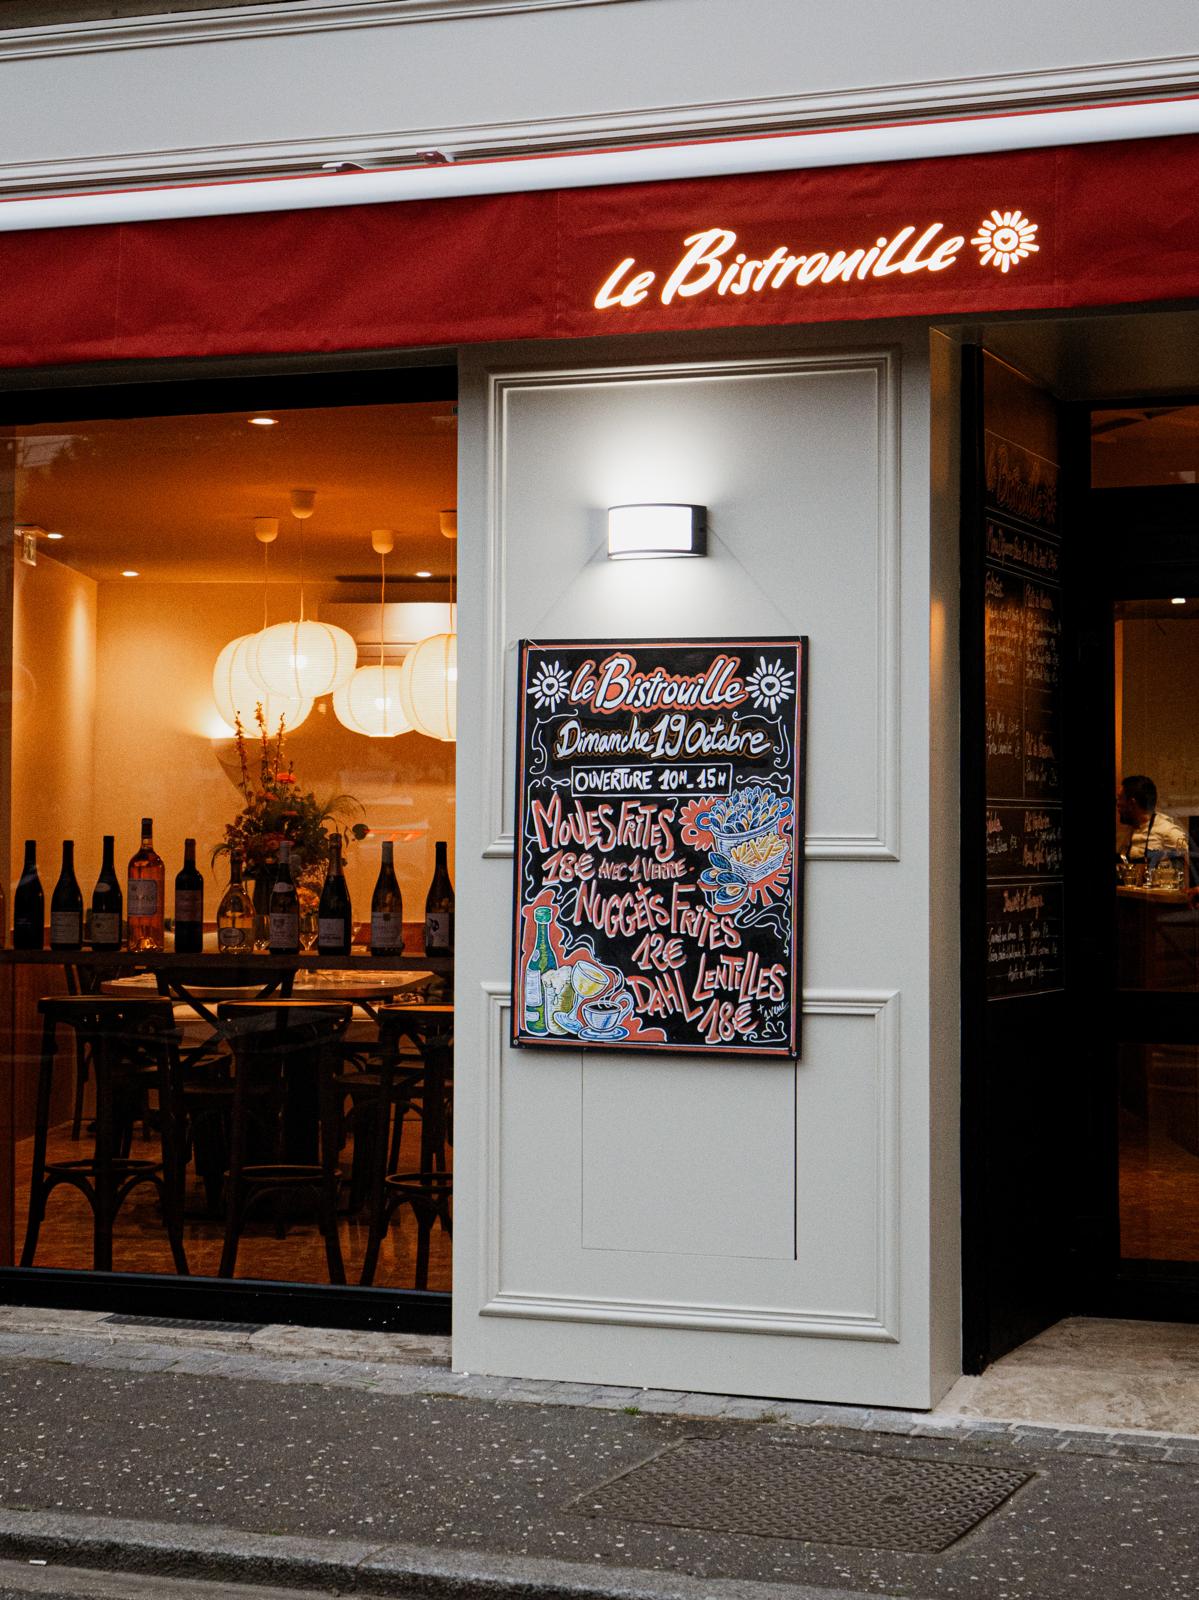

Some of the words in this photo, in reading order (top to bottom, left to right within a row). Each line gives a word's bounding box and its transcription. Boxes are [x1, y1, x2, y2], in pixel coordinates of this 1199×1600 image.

[594, 258, 655, 309] Le
[660, 222, 965, 305] Bistrouille
[594, 656, 747, 711] Bistrouille
[556, 716, 655, 758] Dimanche
[650, 714, 686, 758] 19
[685, 718, 771, 754] Octobre
[574, 768, 653, 792] OUVERTURE
[658, 769, 687, 790] 10H
[531, 791, 617, 853] MOULES
[541, 849, 596, 886] 18€
[598, 857, 628, 881] AVEC
[628, 854, 642, 883] 1
[641, 857, 688, 882] VERRE
[573, 879, 670, 938] NUGGETS
[631, 933, 688, 971] 12€
[625, 969, 704, 1023] DAHL
[697, 999, 760, 1044] 18€
